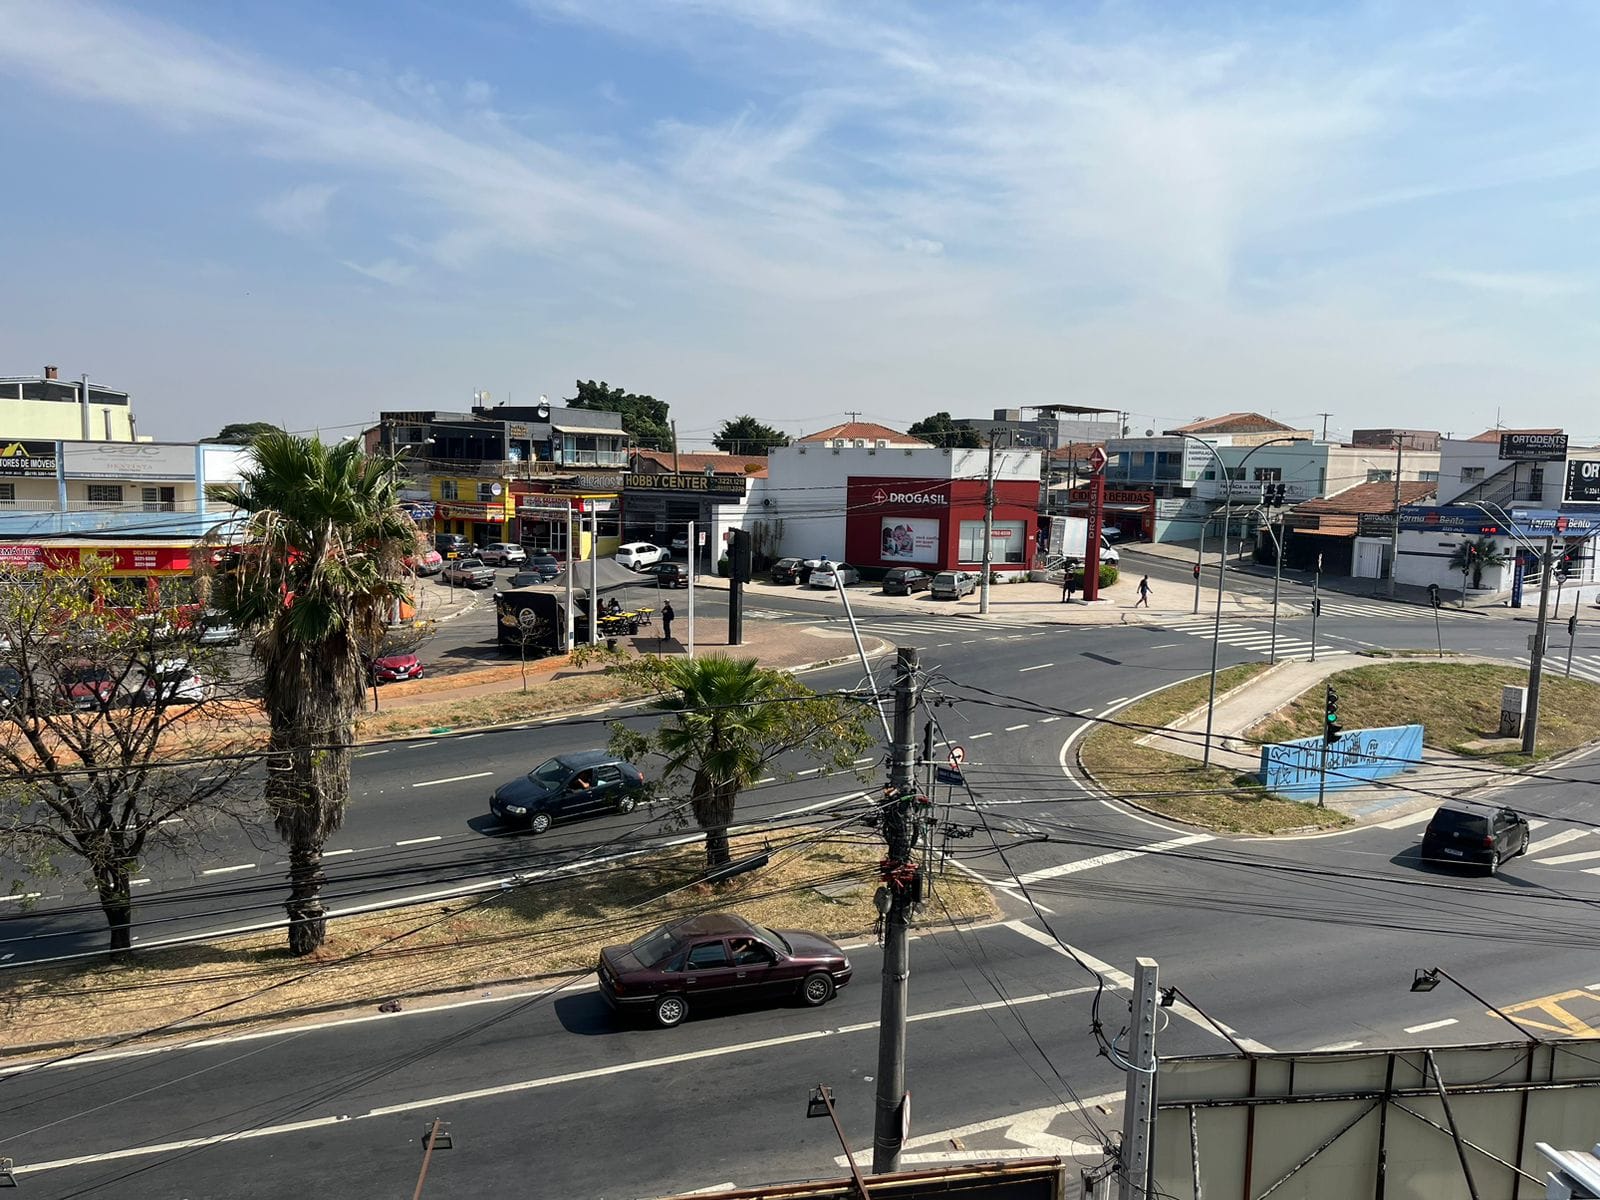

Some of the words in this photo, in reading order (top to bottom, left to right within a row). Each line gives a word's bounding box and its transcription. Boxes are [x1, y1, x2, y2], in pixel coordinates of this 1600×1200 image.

[1512, 435, 1567, 445] ORTODENTS
[20, 458, 30, 468] DE
[30, 456, 56, 469] IMÓVEIS
[625, 475, 660, 487] HOBBY
[661, 476, 708, 489] CENTER
[1567, 459, 1576, 501] DENTISTA
[890, 492, 948, 504] DROGASIL
[1109, 492, 1151, 503] BEBIDAS
[1440, 515, 1465, 525] Bento
[1567, 518, 1591, 528] Bento
